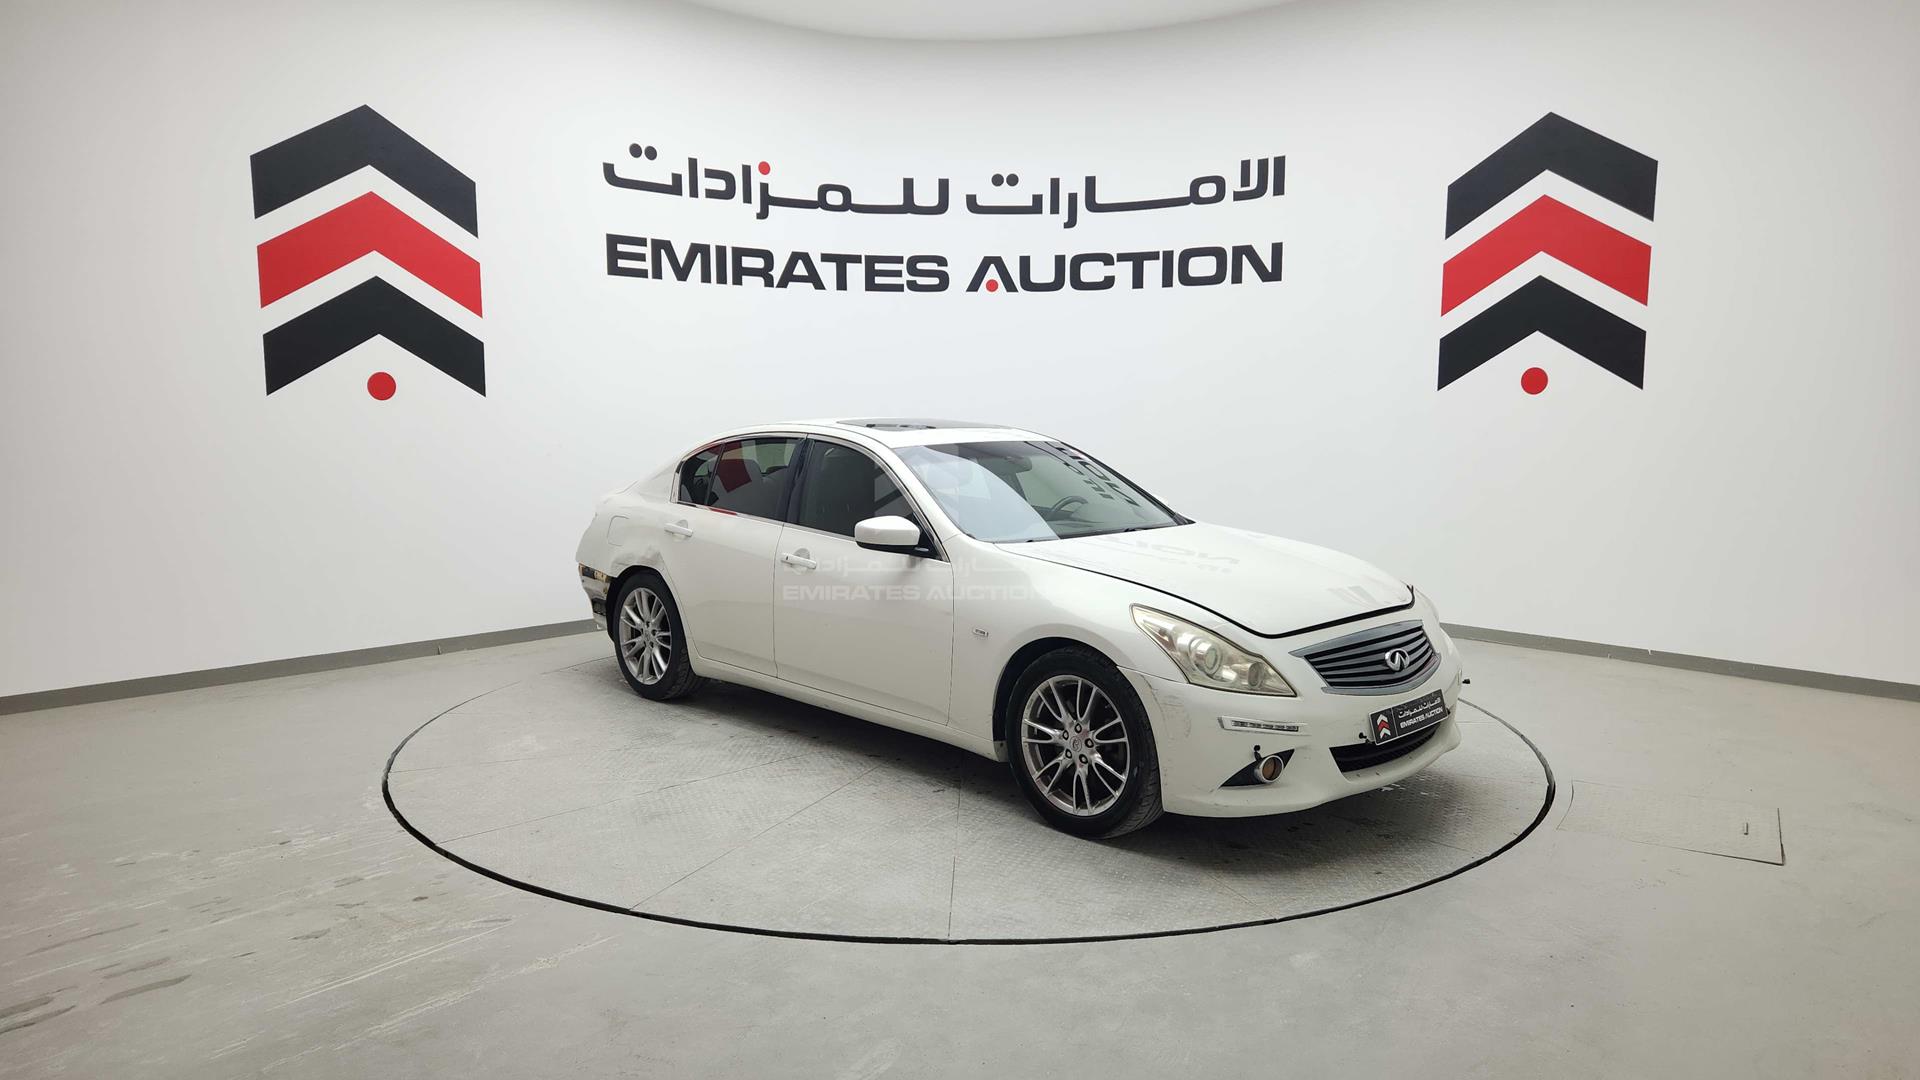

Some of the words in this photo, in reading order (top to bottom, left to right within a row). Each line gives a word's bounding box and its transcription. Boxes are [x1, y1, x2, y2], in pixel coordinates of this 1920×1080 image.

[602, 143, 950, 220] للمزادات
[965, 154, 1287, 229] الامارات
[605, 233, 950, 293] EMIRATES
[965, 241, 1284, 293] AUCTION
[1400, 714, 1425, 729] EMIRATES
[1425, 706, 1444, 719] AUCTION
